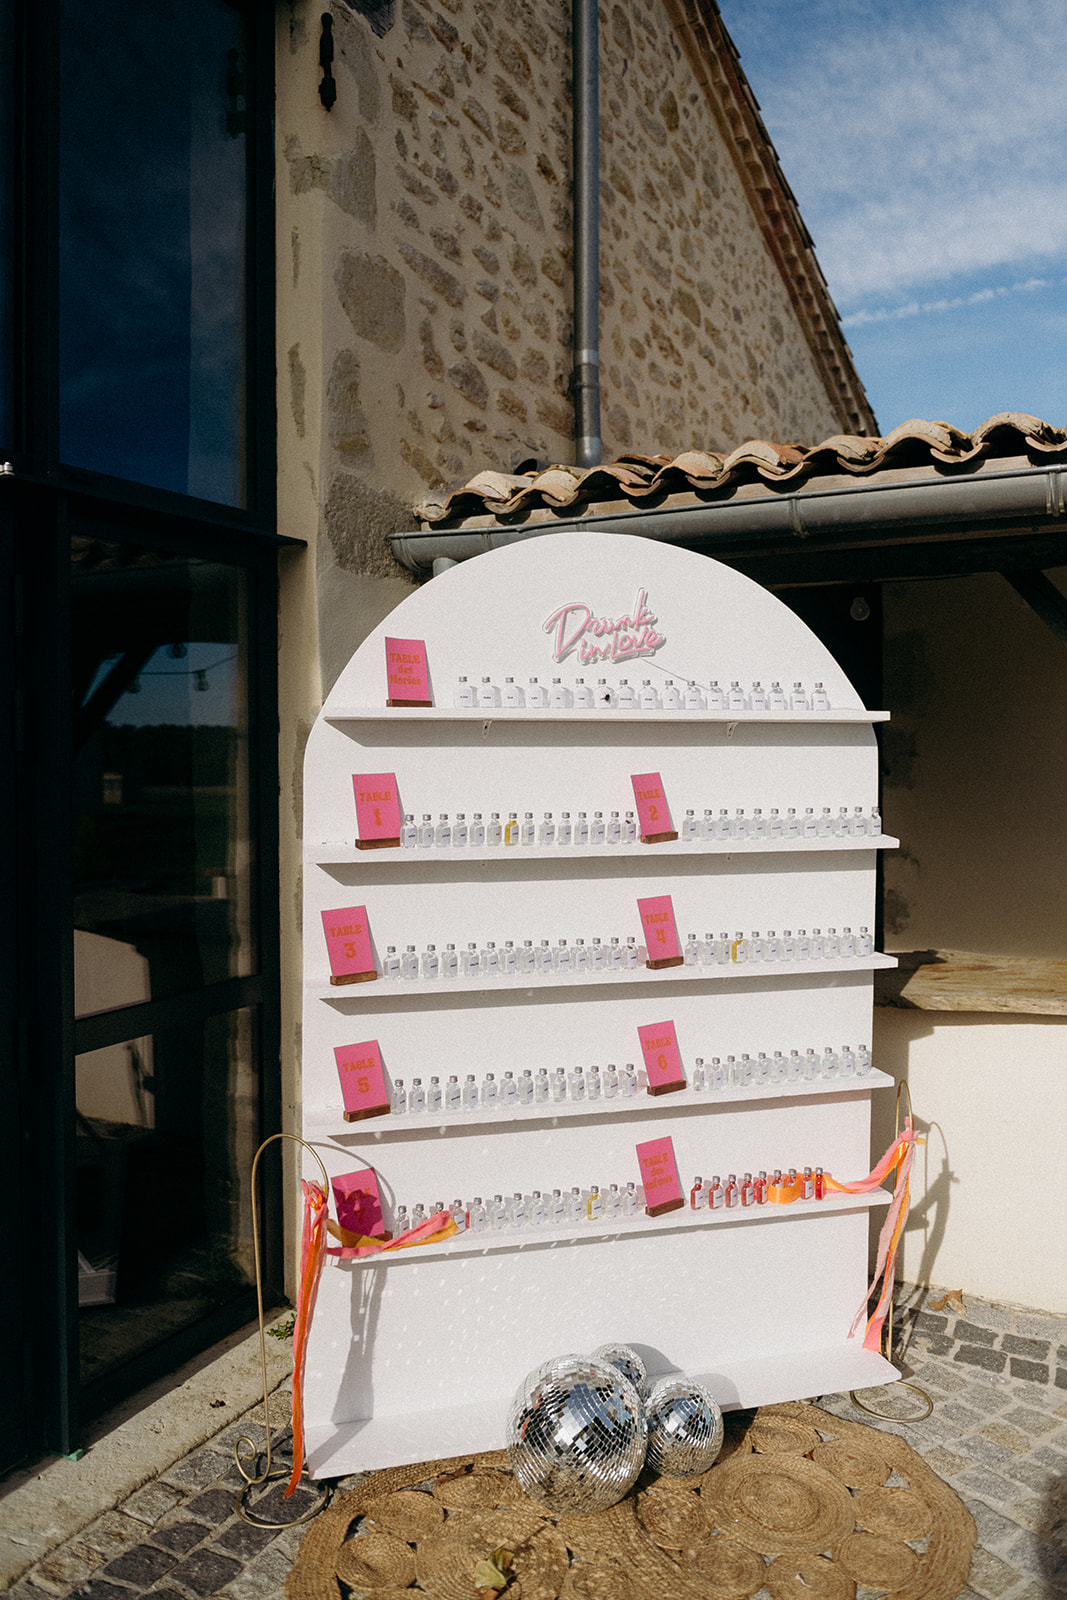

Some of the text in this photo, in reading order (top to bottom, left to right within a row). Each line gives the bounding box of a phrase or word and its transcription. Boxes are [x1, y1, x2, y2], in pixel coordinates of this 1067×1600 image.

[543, 588, 656, 660] Drunk
[580, 625, 664, 660] in Love
[389, 652, 421, 665] TABLE
[397, 664, 414, 675] des
[358, 791, 393, 803] TABLE
[637, 788, 662, 800] TABLE
[373, 807, 383, 827] 1
[648, 805, 659, 821] 2
[643, 911, 670, 925] TABLE
[329, 924, 363, 938] TABLE
[655, 928, 667, 945] 4
[343, 941, 357, 959] 3
[644, 1036, 672, 1051] TABLE
[342, 1057, 376, 1073] TABLE
[657, 1053, 668, 1071] 6
[357, 1075, 371, 1094] 5
[642, 1152, 669, 1169] TABLE
